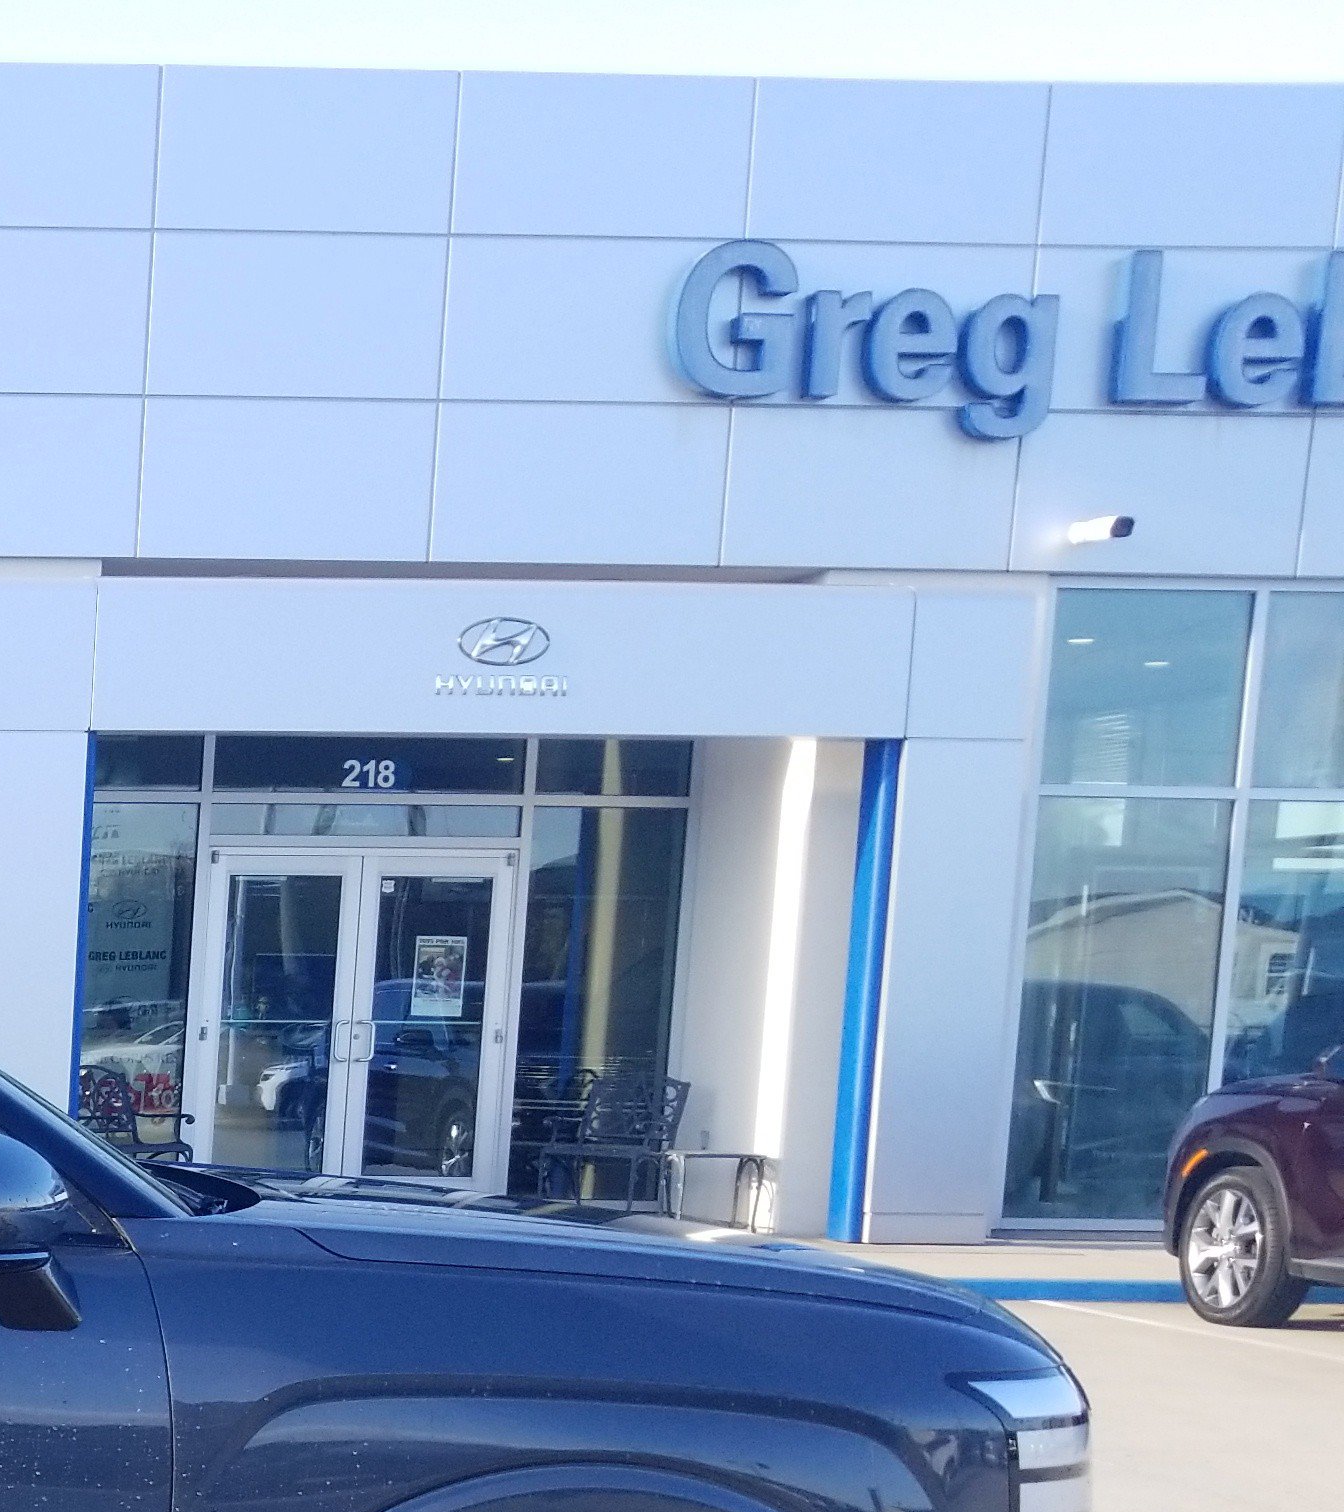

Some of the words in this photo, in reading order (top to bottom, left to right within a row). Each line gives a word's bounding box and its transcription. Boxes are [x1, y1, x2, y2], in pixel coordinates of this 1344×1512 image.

[670, 239, 1060, 441] Greg
[1109, 248, 1344, 410] Le
[434, 673, 569, 697] HYUNDAI
[341, 758, 396, 789] 218
[106, 921, 152, 930] HYUNDAI
[88, 950, 116, 962] GREG
[119, 950, 167, 962] LEBLANC
